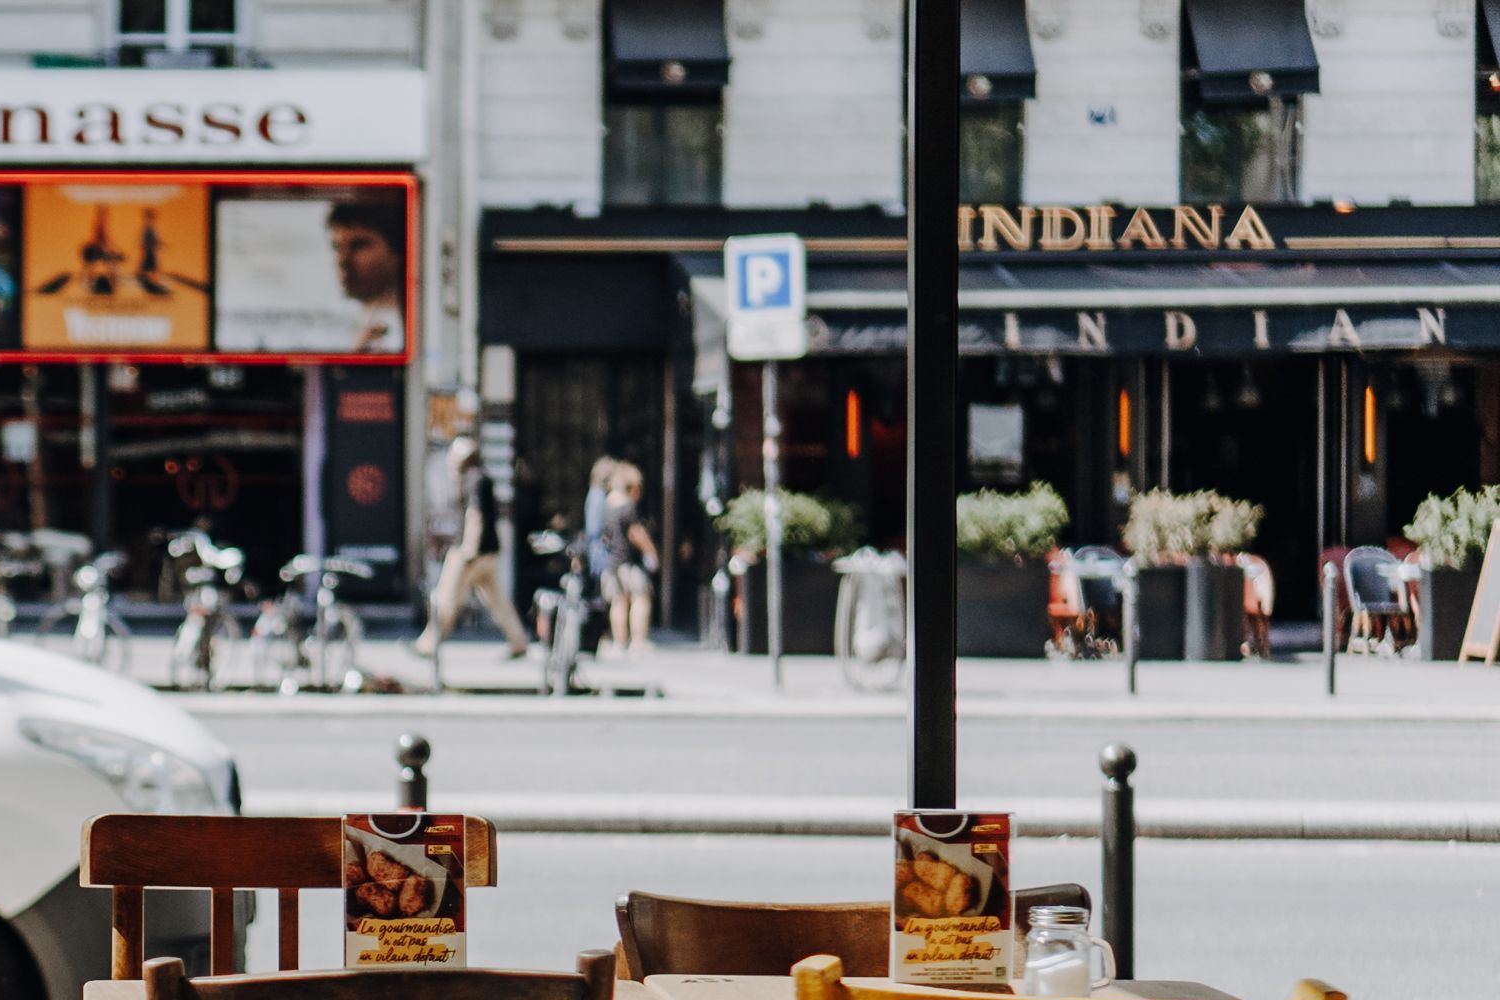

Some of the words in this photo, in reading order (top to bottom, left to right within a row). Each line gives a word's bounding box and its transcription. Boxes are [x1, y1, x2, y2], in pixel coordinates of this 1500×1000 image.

[958, 204, 1276, 250] INDIANA
[745, 254, 784, 306] P
[360, 920, 376, 934] La
[378, 917, 456, 941] gourmandise
[407, 935, 428, 949] pas
